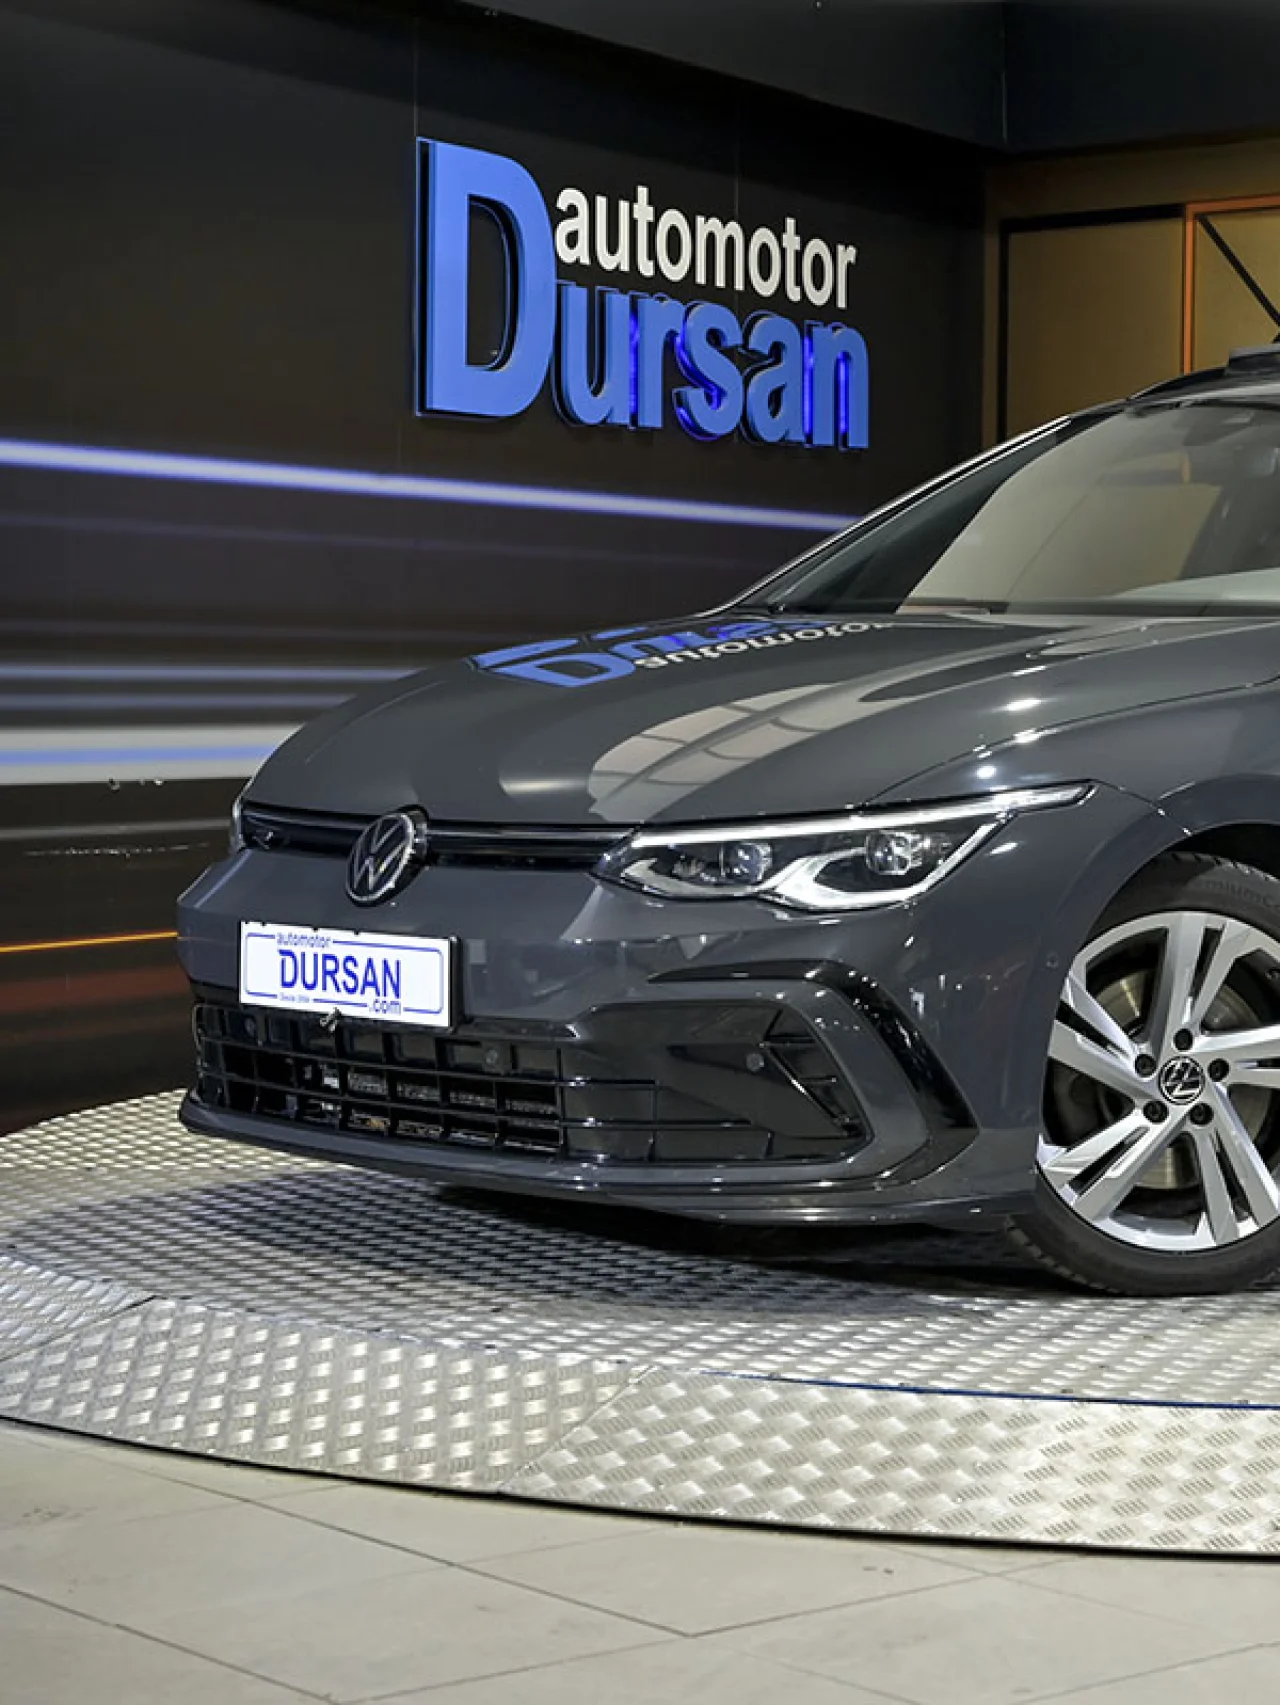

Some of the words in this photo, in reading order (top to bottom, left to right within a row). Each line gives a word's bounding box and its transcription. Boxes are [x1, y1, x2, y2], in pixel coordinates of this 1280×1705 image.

[555, 185, 857, 309] automotor
[416, 137, 870, 451] Dursan
[277, 932, 331, 948] automotor
[279, 949, 401, 999] DURSAN
[368, 998, 402, 1015] .com
